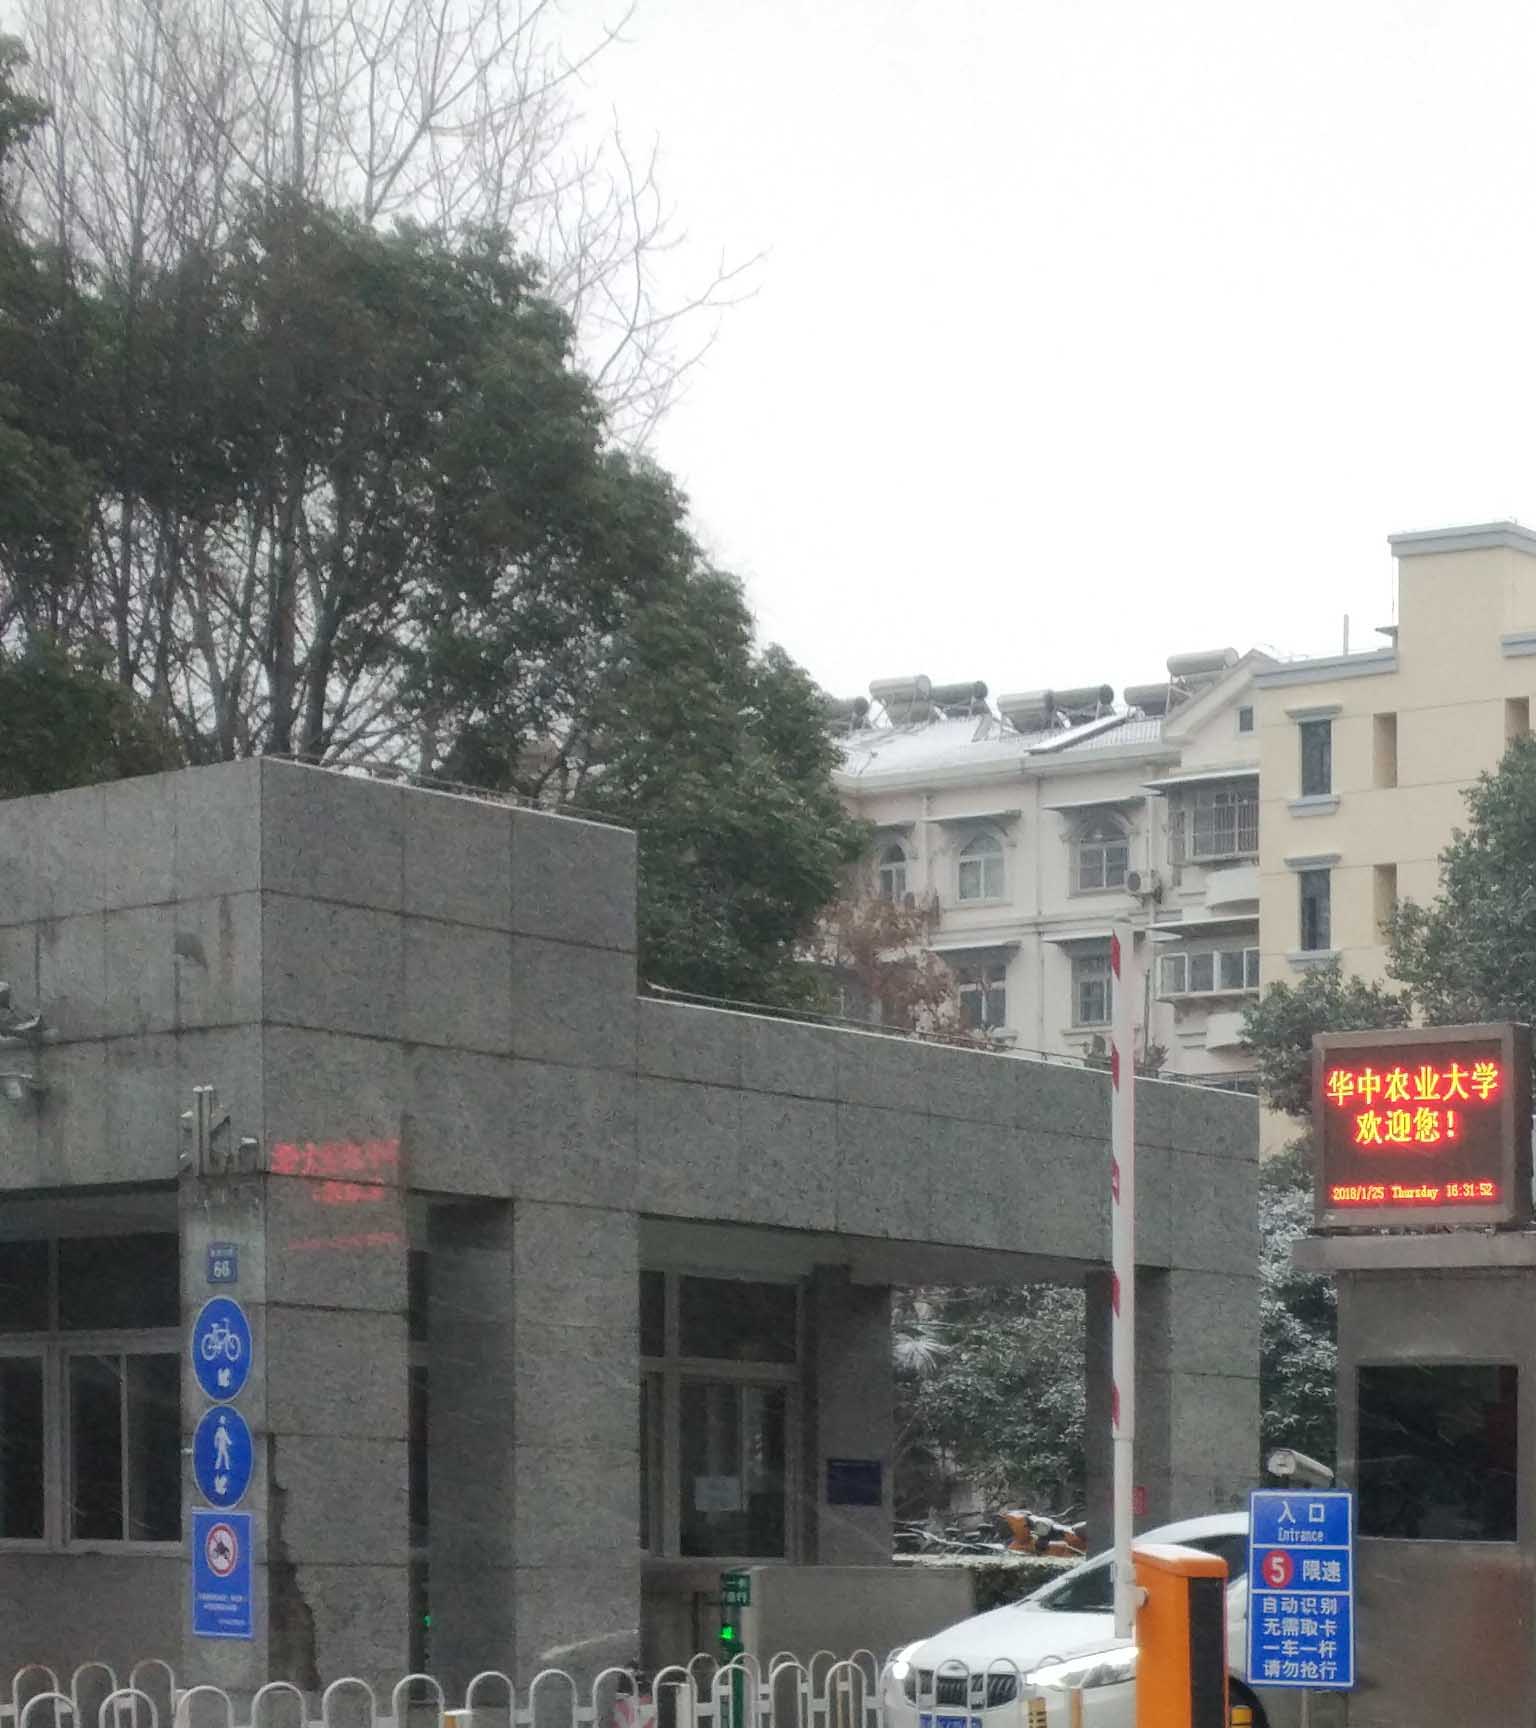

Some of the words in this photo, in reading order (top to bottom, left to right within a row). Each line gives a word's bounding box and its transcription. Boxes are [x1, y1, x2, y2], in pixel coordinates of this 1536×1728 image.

[1327, 1062, 1499, 1106] 华中农业大学
[1355, 1107, 1456, 1145] 欢迎您！
[1392, 1185, 1439, 1200] Thursday
[1277, 1501, 1325, 1524] 入口
[1278, 1528, 1324, 1542] Entrance
[1270, 1557, 1285, 1583] 5
[1302, 1559, 1341, 1583] 限速
[1263, 1597, 1338, 1616] 自动识别
[1263, 1617, 1338, 1637] 无需取卡
[1263, 1639, 1337, 1659] 一车一杆
[1263, 1660, 1338, 1680] 请勿抢行
